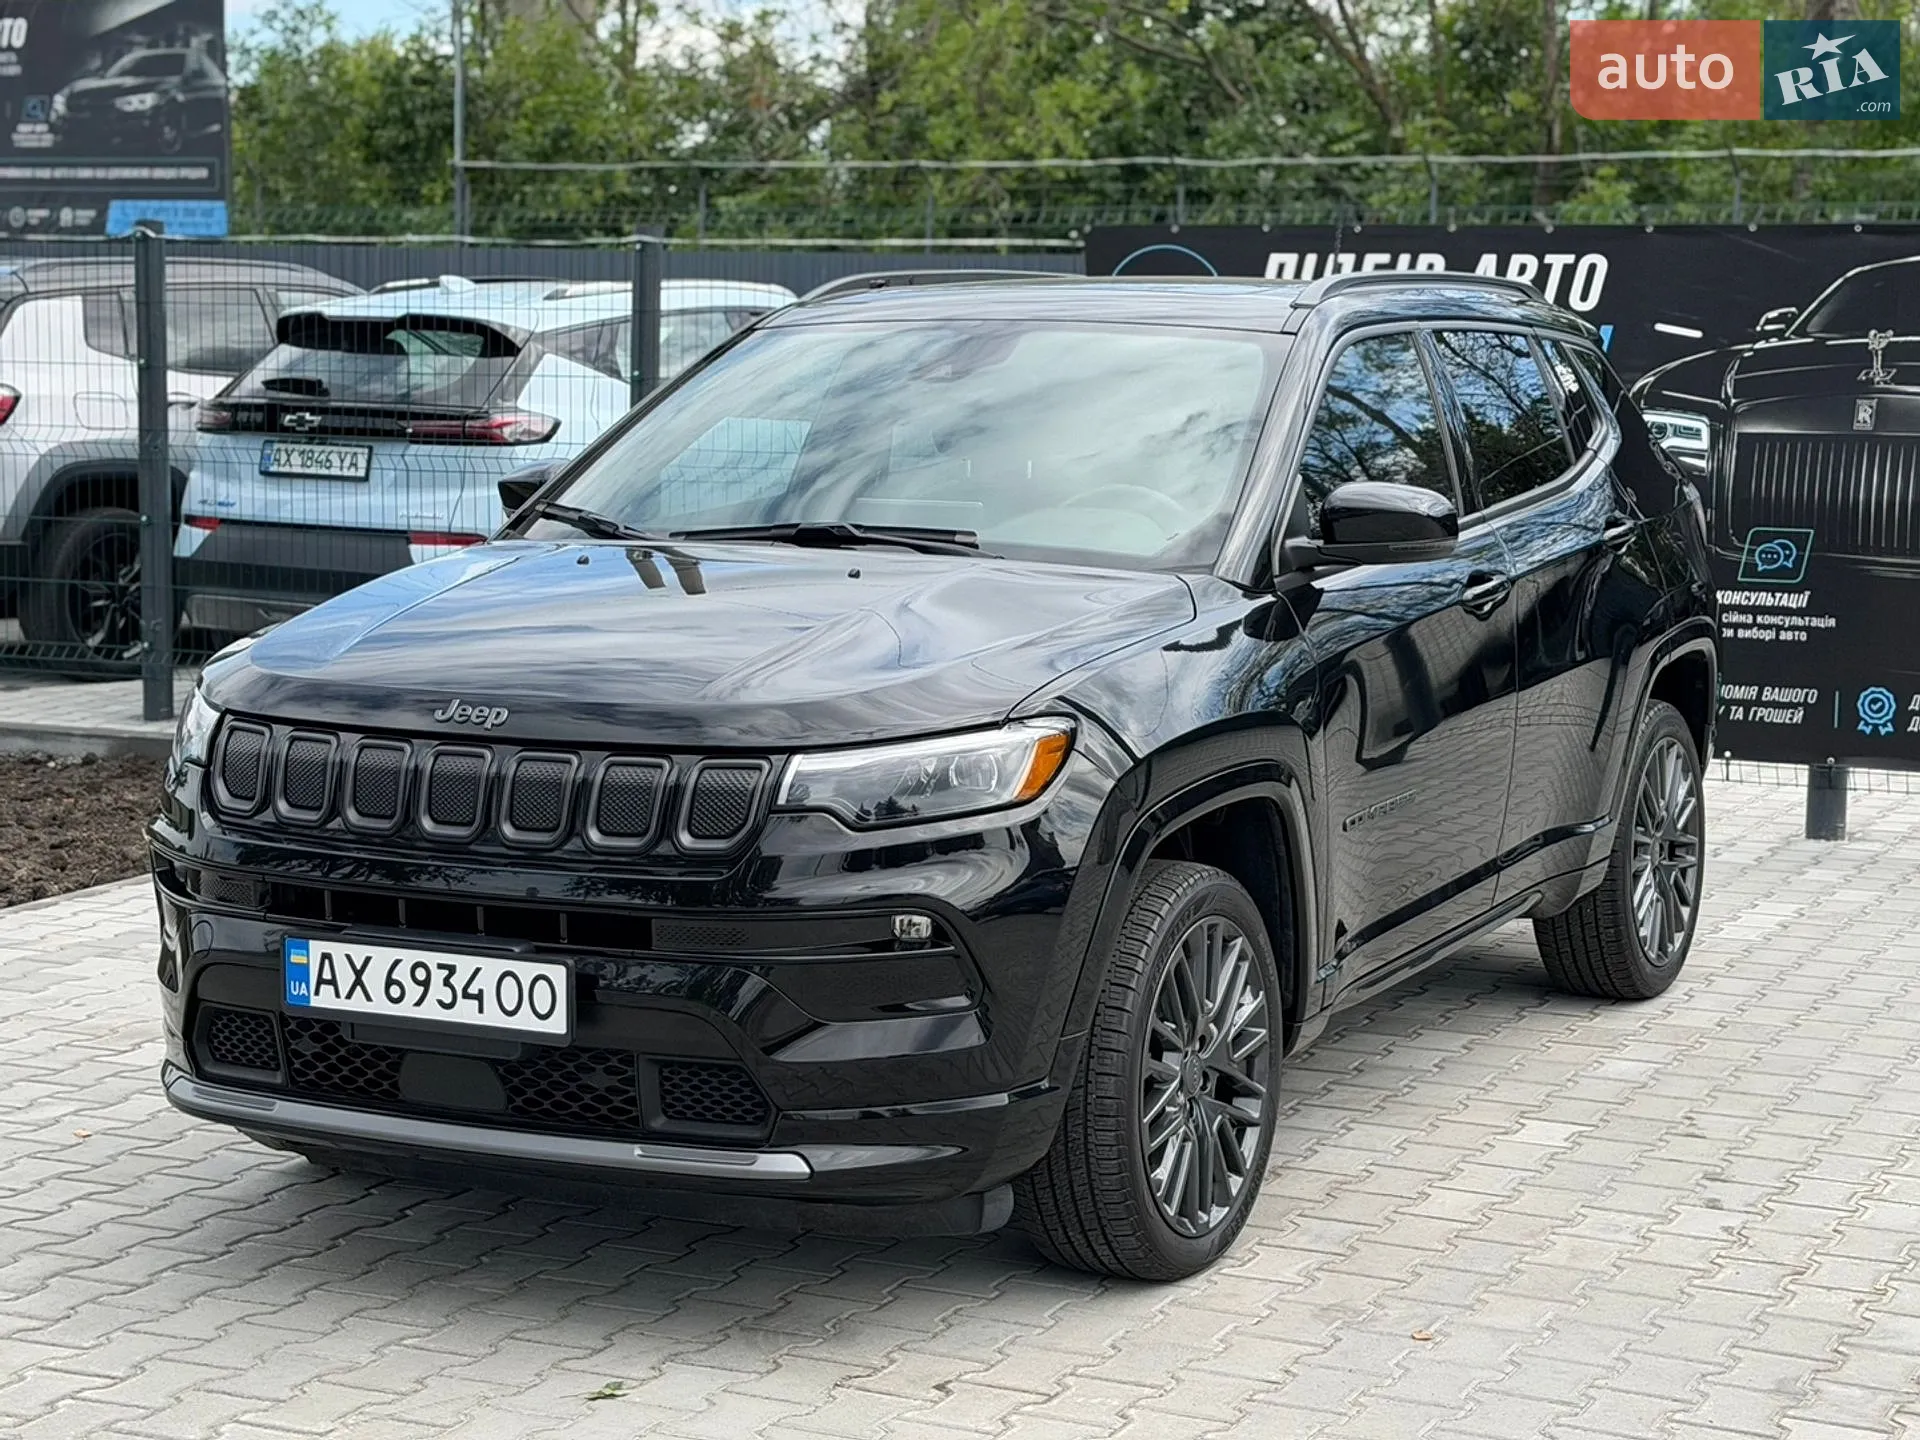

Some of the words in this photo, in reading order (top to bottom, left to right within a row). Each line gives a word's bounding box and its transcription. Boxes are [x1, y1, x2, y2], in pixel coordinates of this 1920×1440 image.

[1716, 590, 1811, 609] КОНСУЛЬТАЦІЇ
[1756, 614, 1836, 628] консультація
[1737, 626, 1776, 641] виборі
[1779, 630, 1807, 641] авто
[1761, 686, 1818, 704] ВАШОГО
[433, 698, 509, 730] Jeep
[1729, 705, 1744, 720] ТА
[1748, 706, 1804, 724] ГРОШЕЙ
[290, 980, 308, 996] UA
[313, 951, 374, 1003] AX
[383, 957, 485, 1015] 6934
